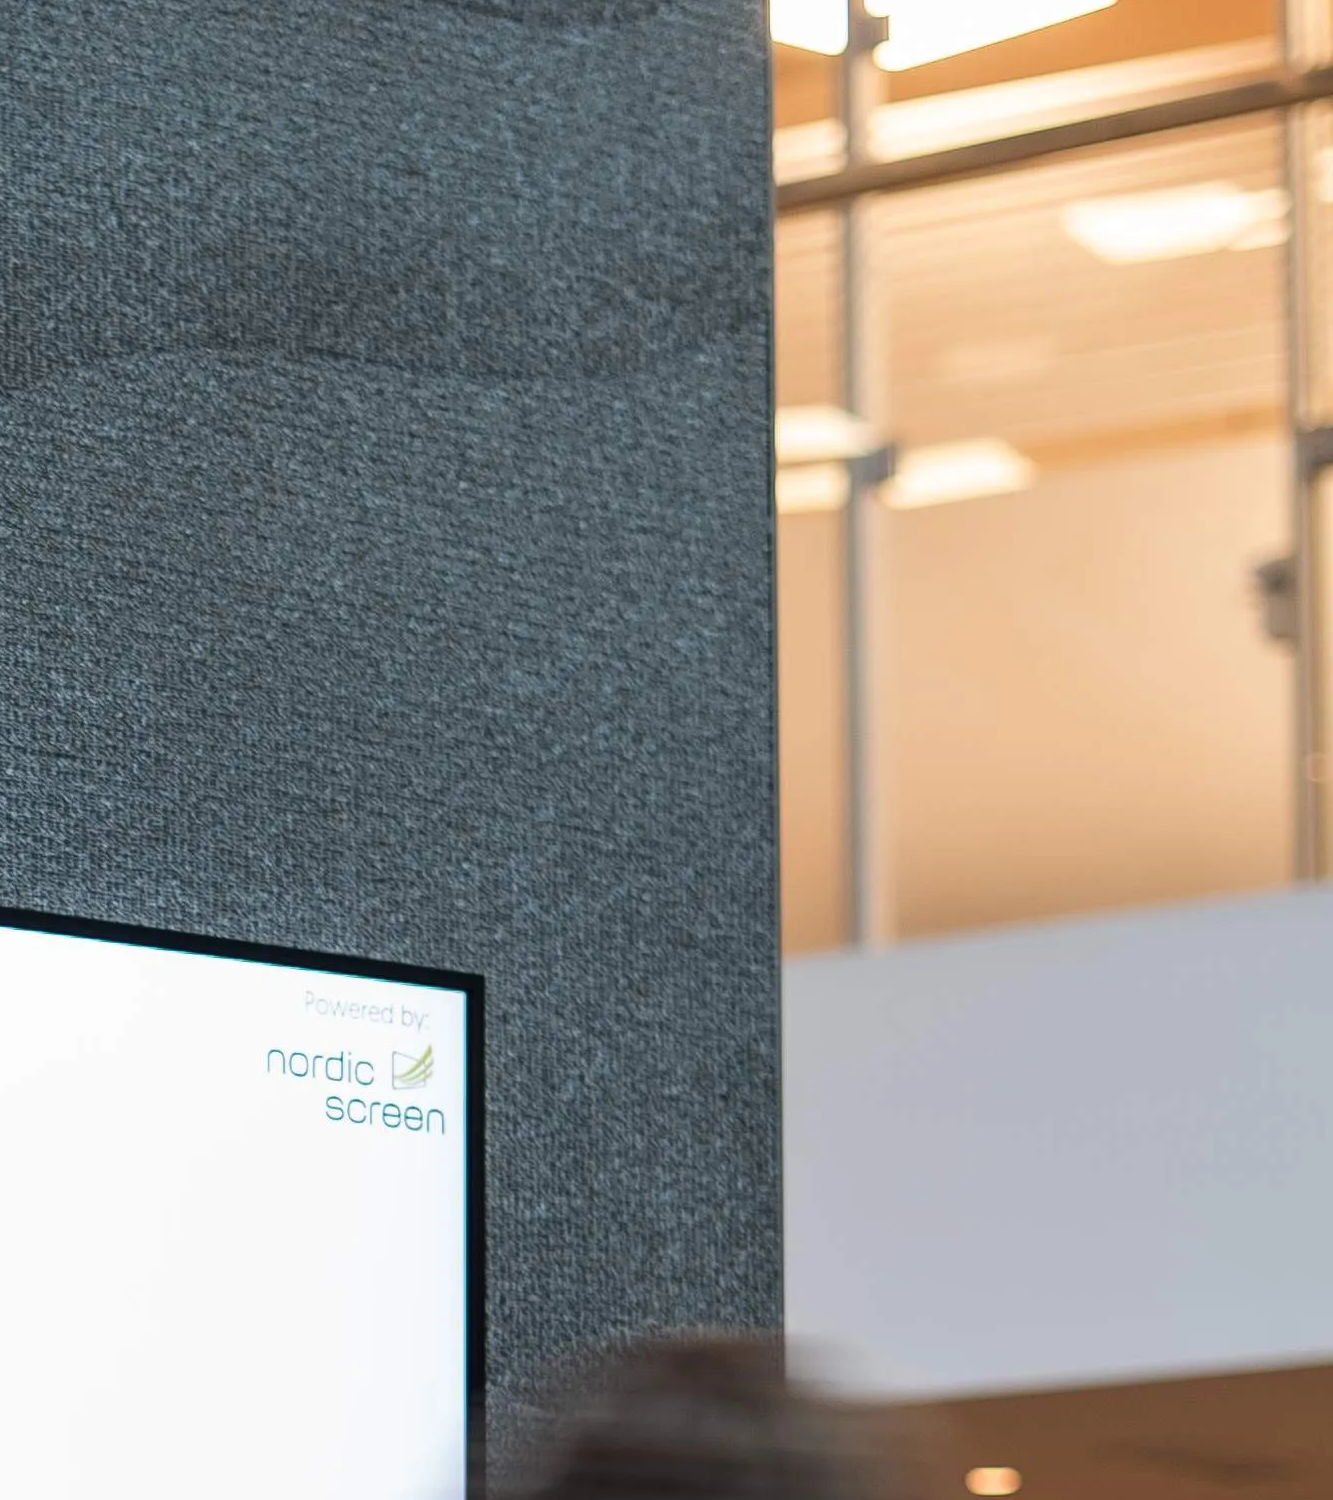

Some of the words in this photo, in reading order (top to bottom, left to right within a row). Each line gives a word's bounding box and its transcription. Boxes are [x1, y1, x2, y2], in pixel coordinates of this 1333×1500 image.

[305, 990, 394, 1024] Powered
[402, 1004, 429, 1031] by:
[267, 1050, 374, 1085] nordic
[325, 1096, 445, 1134] screen
